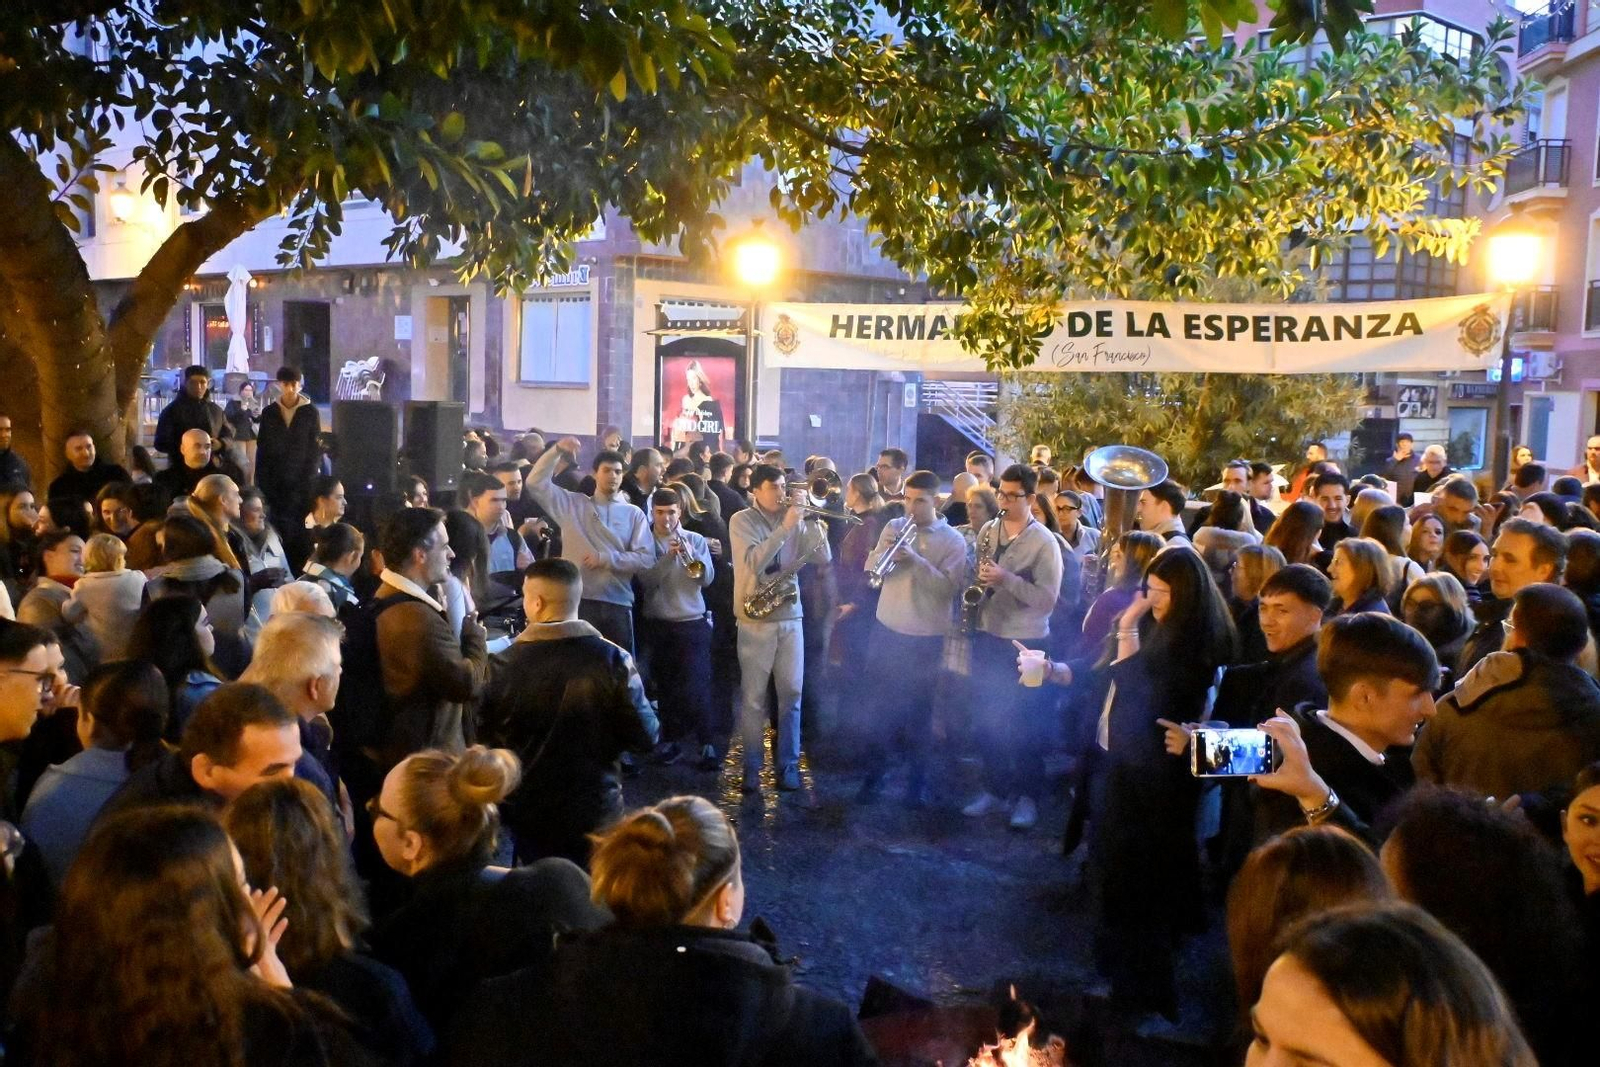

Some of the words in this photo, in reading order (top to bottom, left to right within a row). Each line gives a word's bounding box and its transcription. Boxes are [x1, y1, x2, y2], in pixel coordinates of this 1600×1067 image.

[829, 313, 1055, 340] HERMAD
[1068, 310, 1113, 338] DE
[1126, 311, 1171, 338] LA
[1183, 312, 1424, 342] ESPERANZA
[698, 420, 722, 433] GIRL
